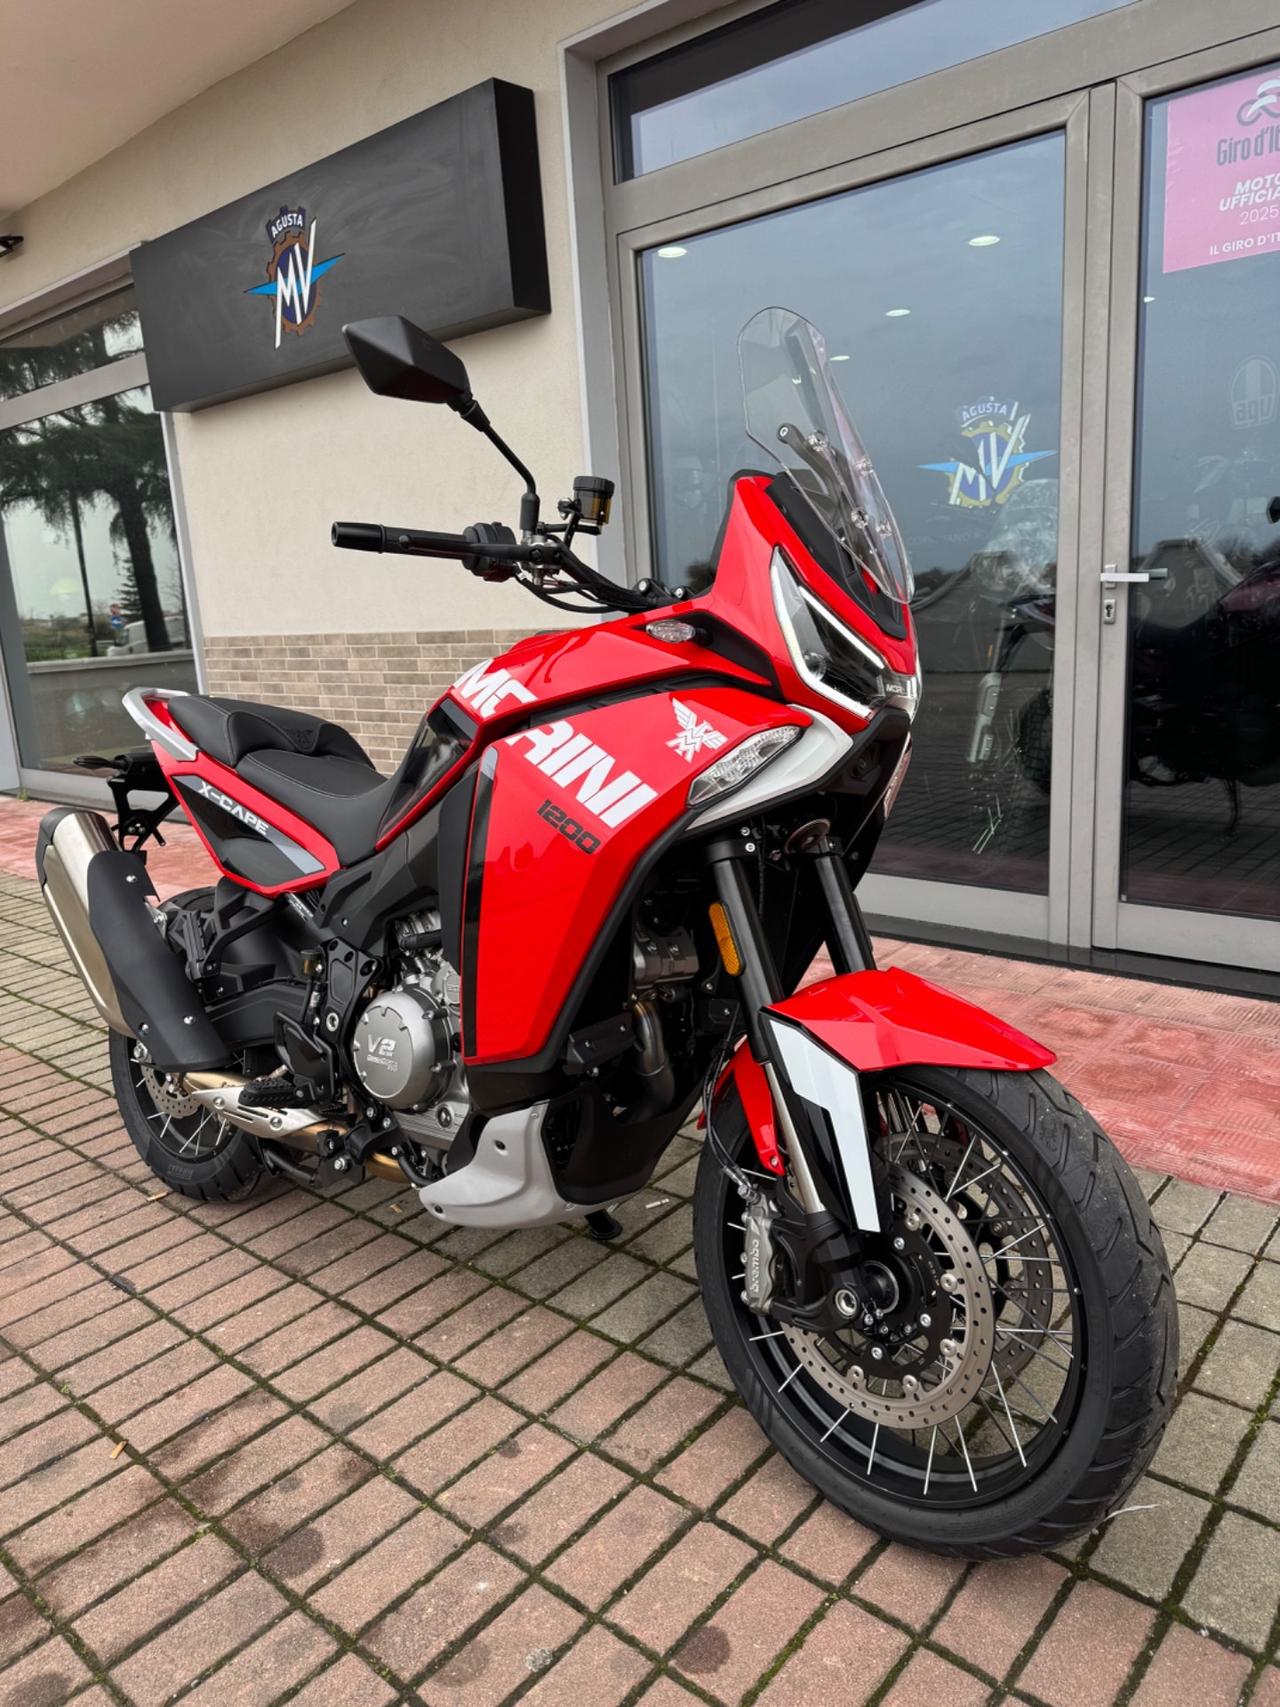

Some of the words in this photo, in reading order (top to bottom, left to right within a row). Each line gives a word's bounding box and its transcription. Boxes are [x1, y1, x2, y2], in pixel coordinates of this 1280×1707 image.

[1217, 136, 1251, 166] Giro
[271, 213, 303, 239] AGUSTA
[1239, 204, 1279, 226] 2025
[1210, 245, 1220, 256] IL
[1222, 237, 1254, 253] GIRO
[275, 219, 317, 349] MV
[961, 402, 1008, 421] AGUSTA
[198, 780, 269, 836] X-CAPE
[536, 799, 602, 855] 1200
[367, 1034, 397, 1057] V2
